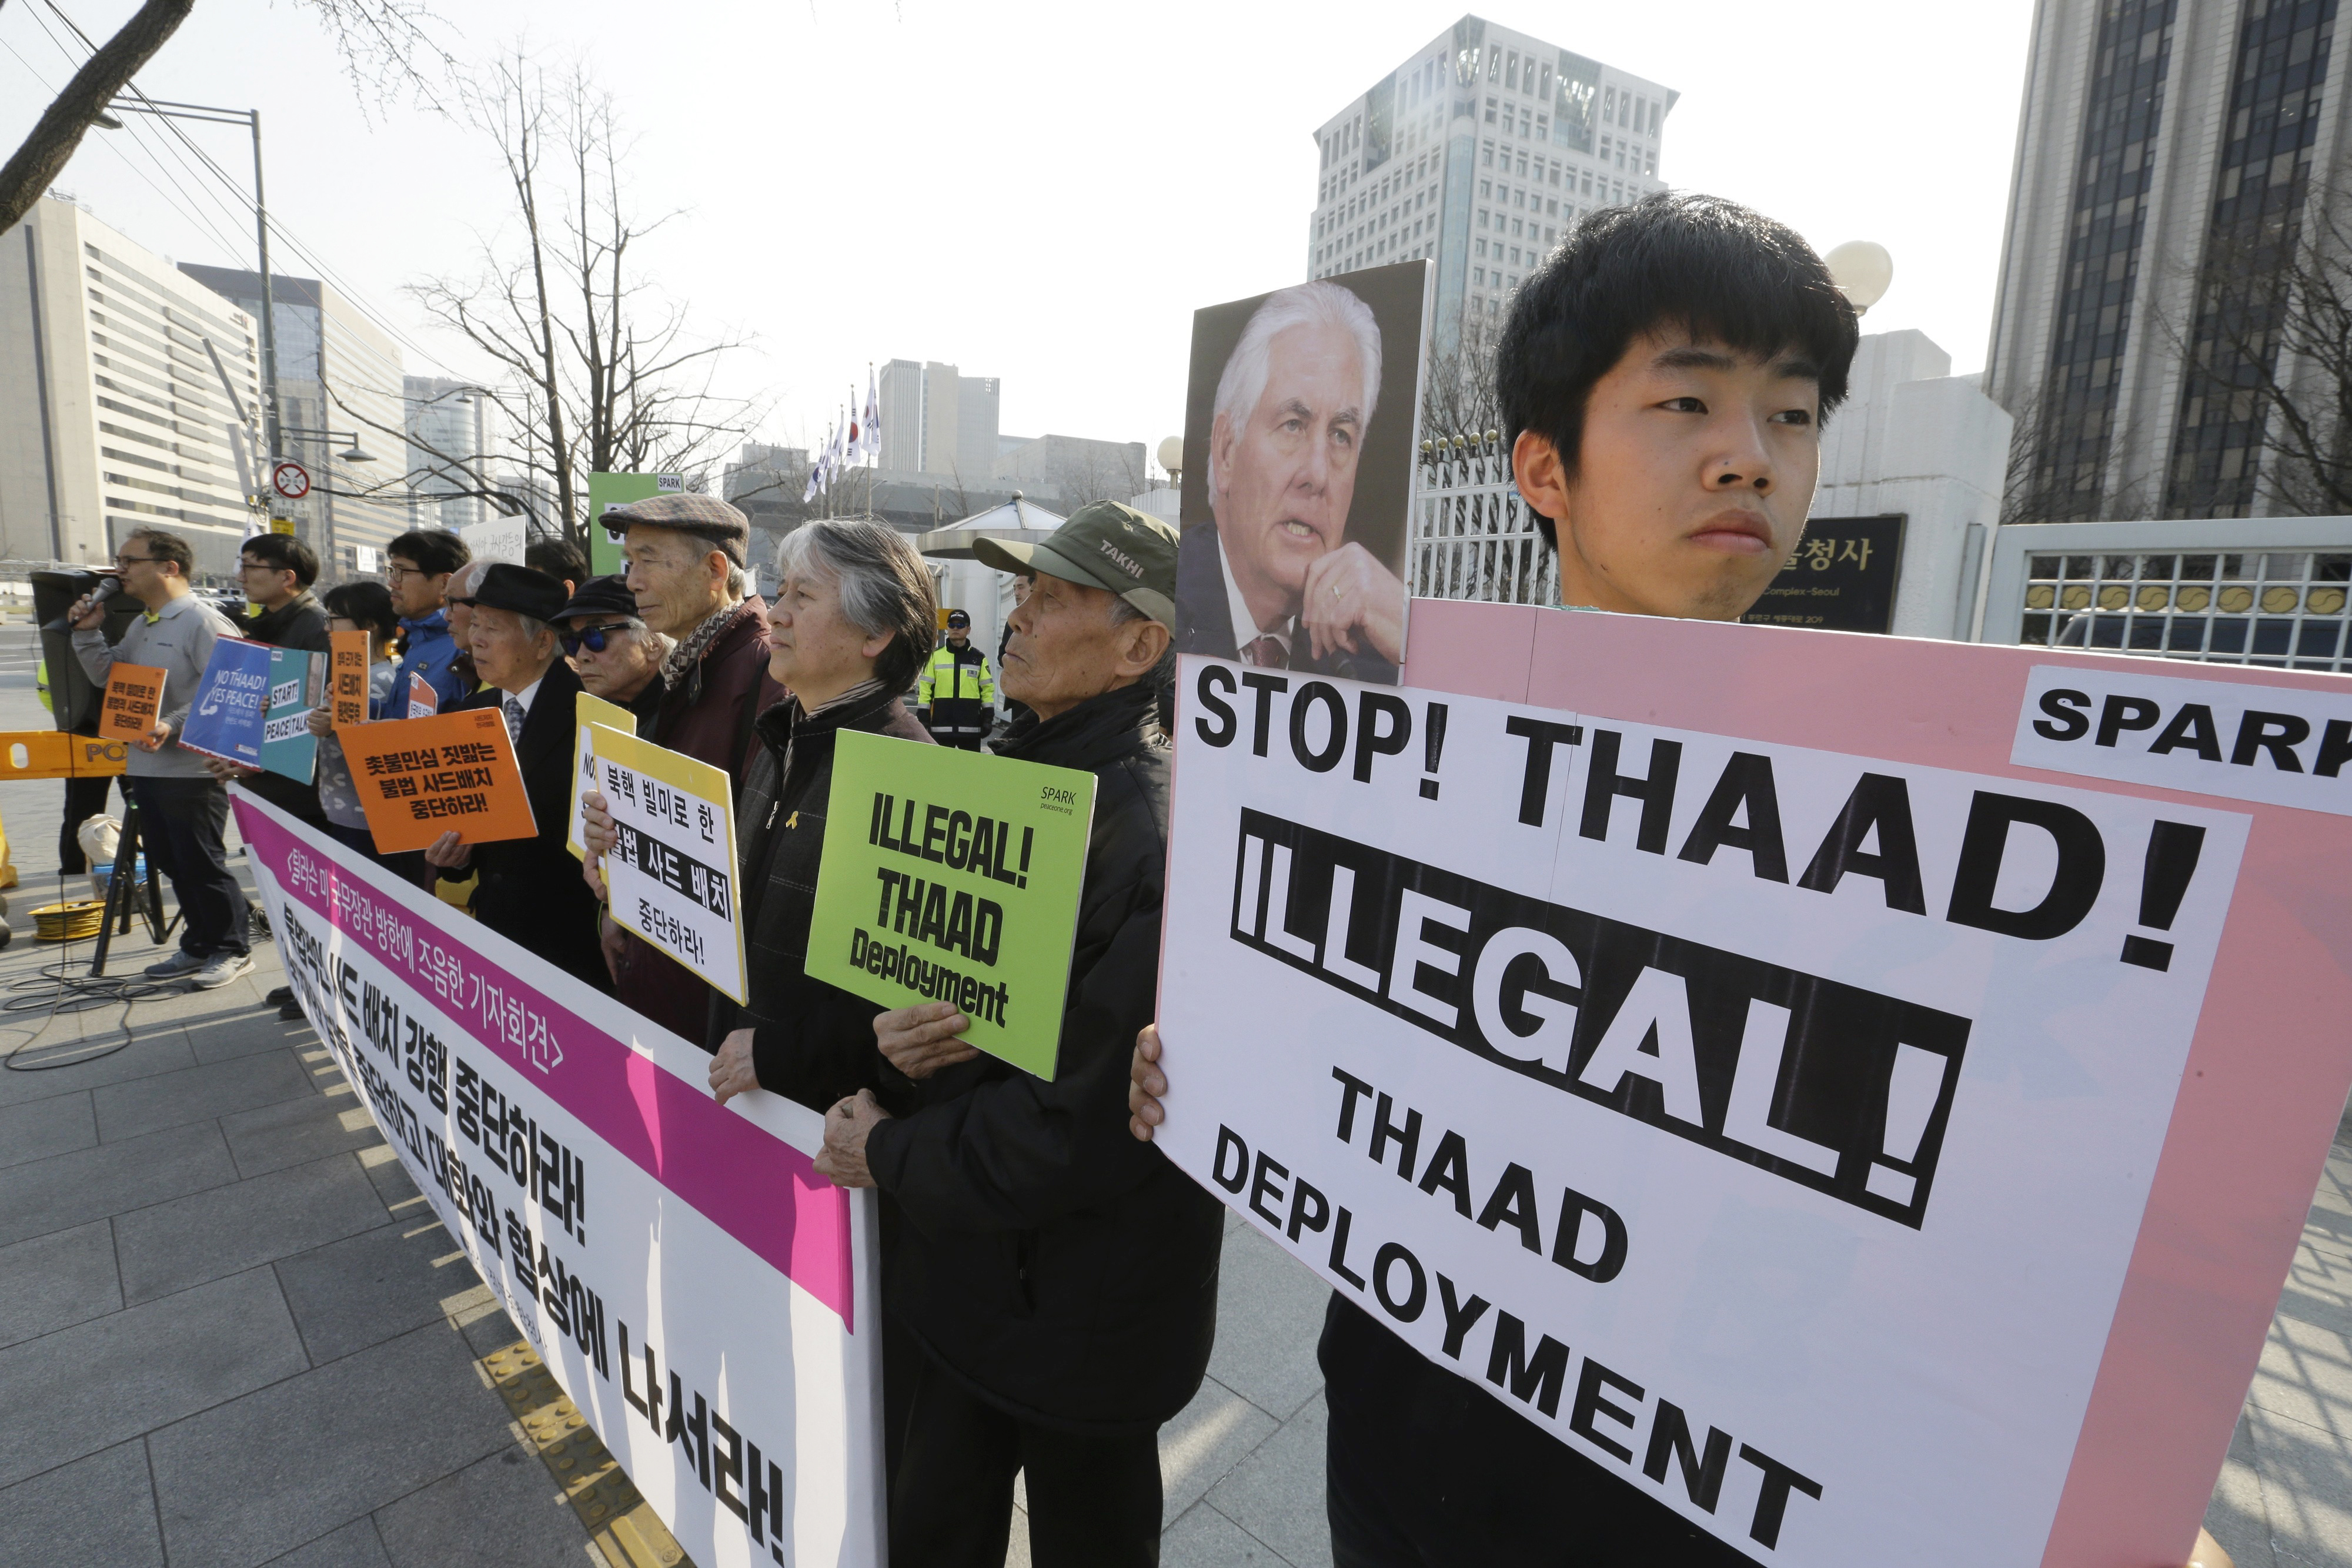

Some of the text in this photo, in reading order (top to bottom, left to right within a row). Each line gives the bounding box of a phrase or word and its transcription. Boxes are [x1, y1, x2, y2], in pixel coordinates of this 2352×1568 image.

[659, 477, 681, 489] SPARK
[1100, 539, 1144, 579] TAKHI
[1763, 587, 1840, 597] Complex-Seoul
[1806, 616, 1825, 624] 209
[211, 687, 259, 709] YES PEACE!
[214, 669, 267, 691] NO THAAD!
[273, 683, 298, 705] START!
[265, 720, 290, 740] PEACE
[292, 714, 309, 734] TALK
[86, 743, 128, 763] PO
[365, 742, 497, 776] 촛불민심 짓밟는
[583, 752, 596, 781] NO
[379, 767, 493, 799] 불법 사드배치
[1040, 786, 1077, 805] SPARK
[410, 793, 489, 820] 중단하라!
[607, 764, 636, 807] 북핵
[642, 778, 690, 830] 빌미로
[697, 803, 714, 844] 한
[1040, 803, 1073, 816] peaceone.org
[1195, 664, 2207, 973] STOP! THAAD!
[869, 792, 1034, 890] ILLEGAL!
[648, 841, 683, 890] 사드
[690, 864, 730, 922] 배치
[639, 897, 705, 965] 중단하라!
[877, 867, 1003, 967] THAAD
[319, 868, 329, 908] 미
[331, 875, 373, 941] 국무장관
[375, 905, 415, 974] 방한에
[419, 937, 465, 1010] 즈음한
[470, 971, 564, 1075] 기자회견>
[850, 927, 1009, 1029] Deployment
[1237, 834, 1948, 1208] ILLEGAL!
[330, 952, 360, 1030] 사드
[362, 979, 399, 1071] 배치
[405, 1013, 449, 1118] 강행
[455, 1053, 586, 1248] 중단하라!
[1332, 1065, 1628, 1284] THAAD
[352, 1041, 429, 1172] 중단하고
[424, 1124, 504, 1261] 대화와
[504, 1206, 610, 1382] 협상에
[617, 1316, 785, 1563] 나서라!
[1212, 1123, 1824, 1552] DEPLOYMENT
